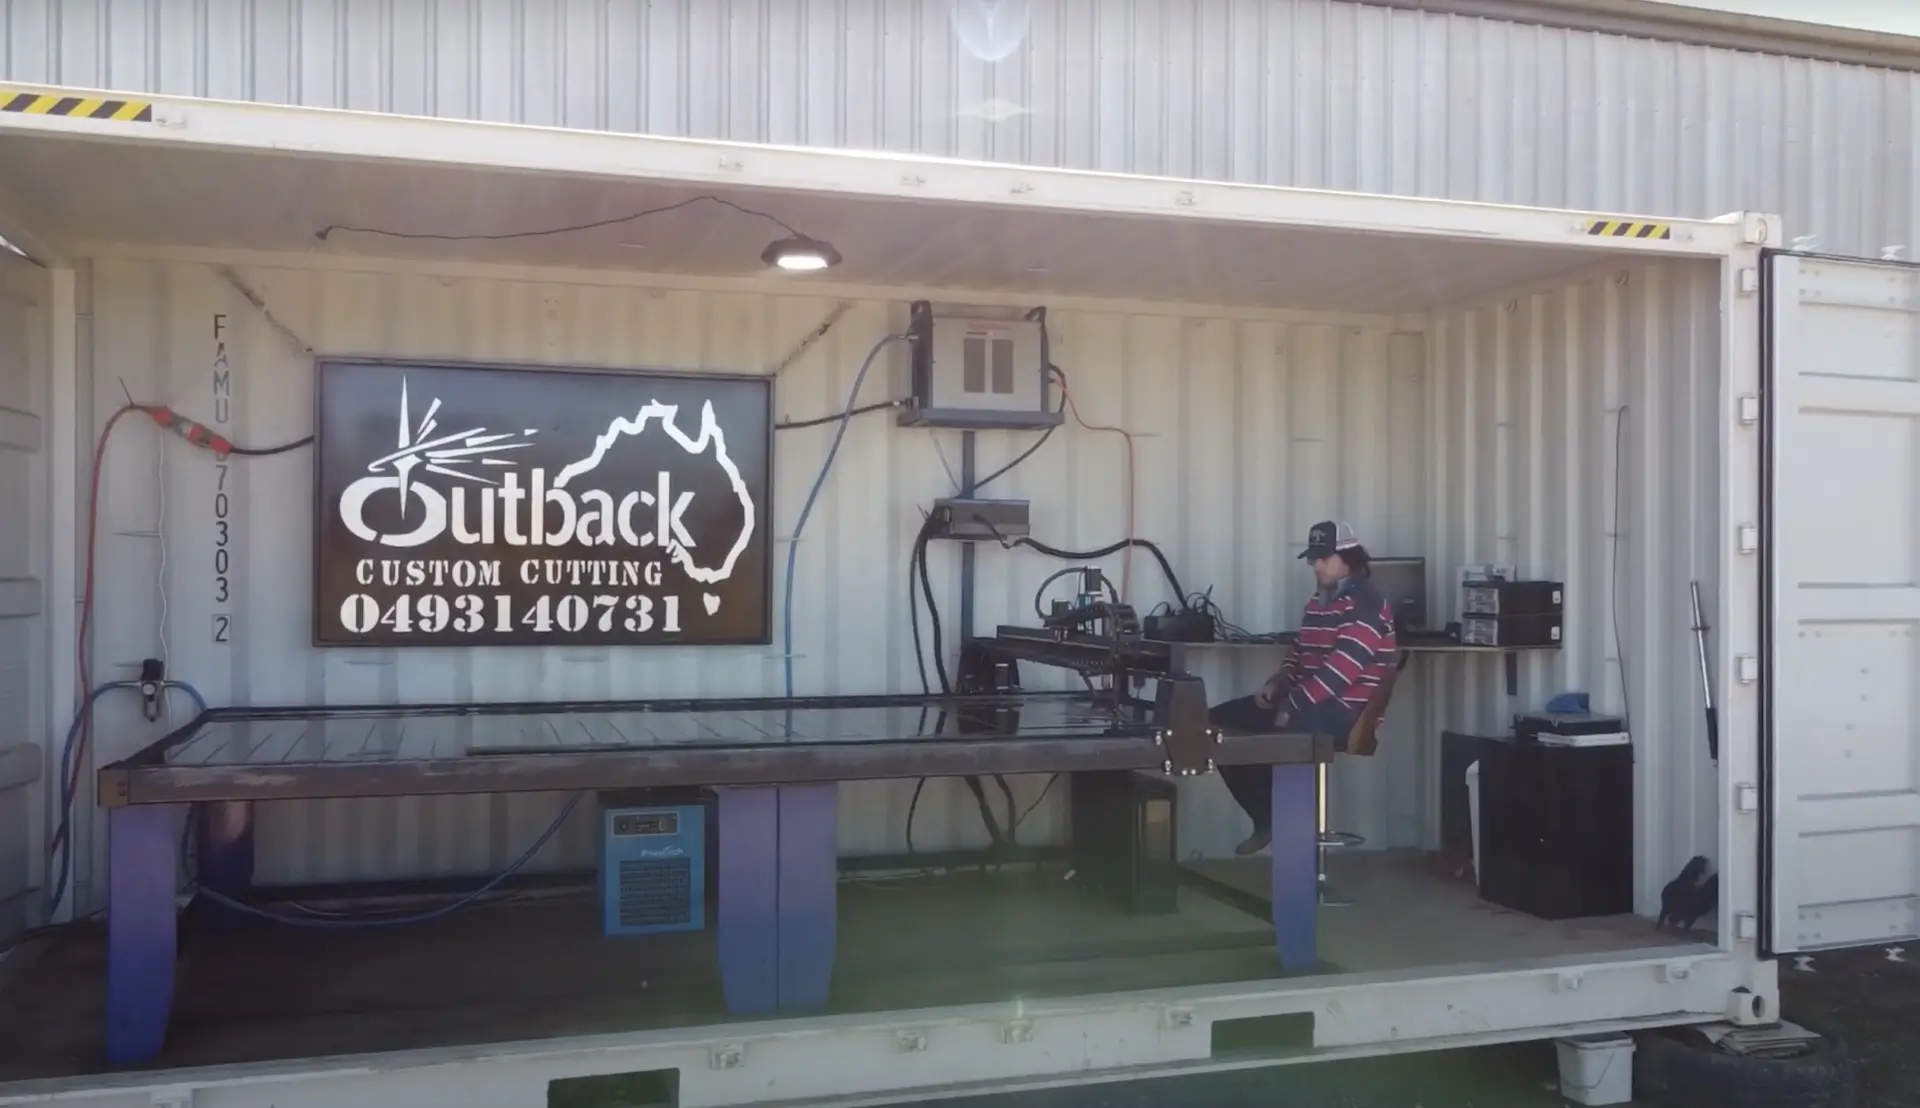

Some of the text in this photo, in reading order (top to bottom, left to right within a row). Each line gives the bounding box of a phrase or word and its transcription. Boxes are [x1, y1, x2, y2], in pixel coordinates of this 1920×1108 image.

[213, 314, 230, 423] FAMU
[339, 468, 696, 547] Outback
[356, 559, 663, 587] CUSTOM CUTTING
[215, 617, 229, 642] 2
[340, 594, 681, 633] 0493140731
